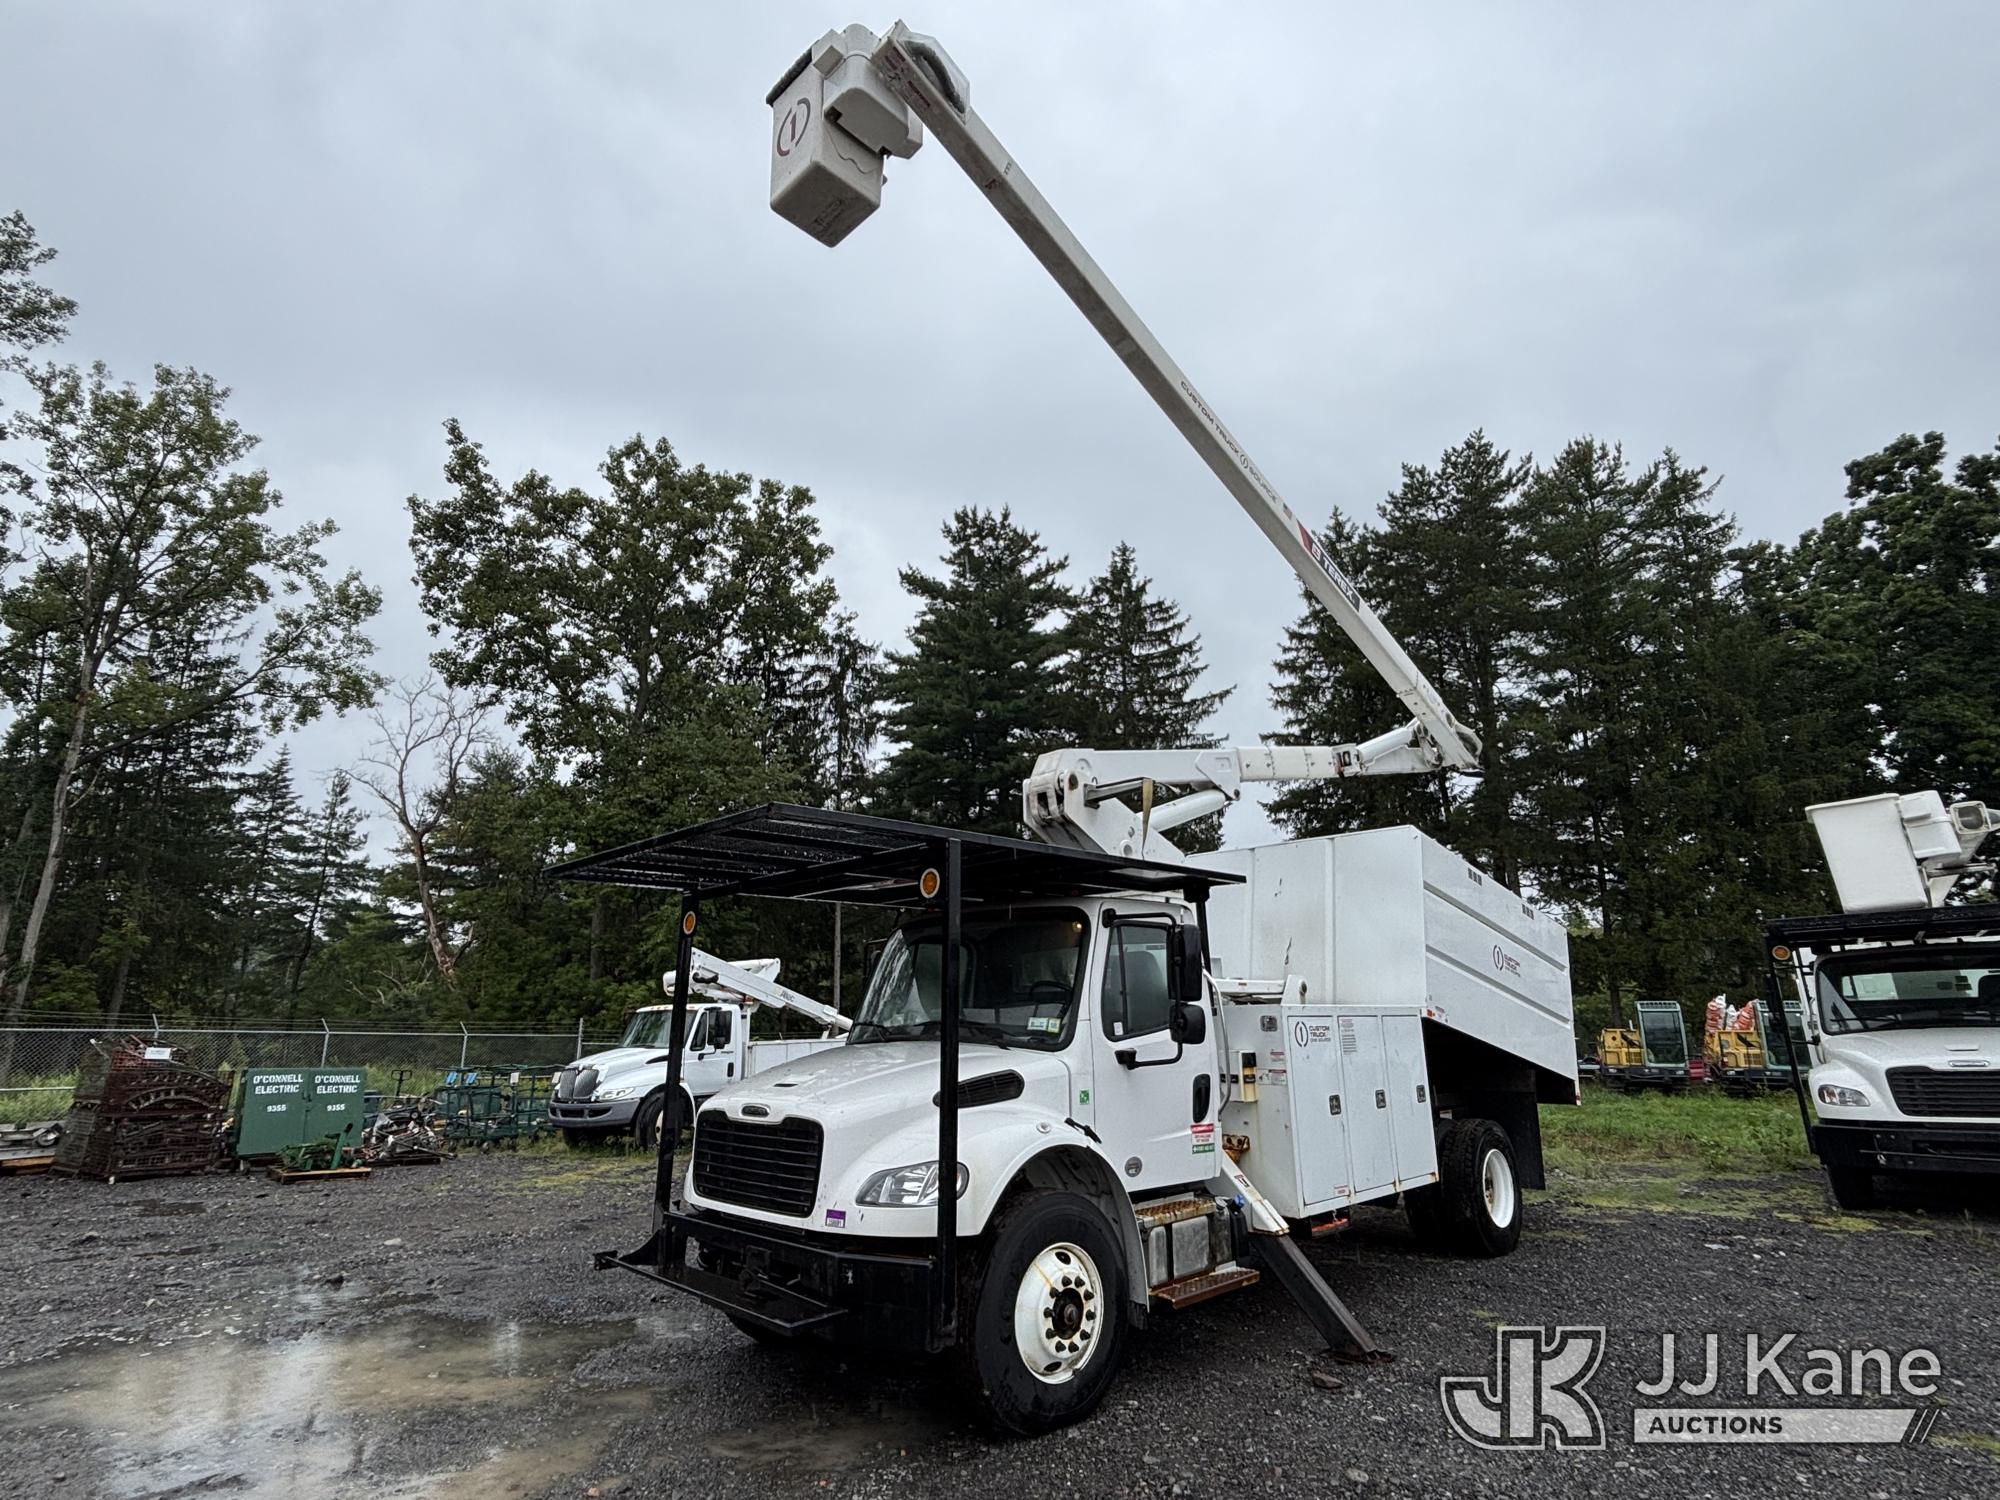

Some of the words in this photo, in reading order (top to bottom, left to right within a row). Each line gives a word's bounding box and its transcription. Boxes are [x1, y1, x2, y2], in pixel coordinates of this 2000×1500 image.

[1181, 381, 1214, 424] CUSTOM
[1215, 423, 1239, 456] TRUCK
[1323, 556, 1356, 605] TEREX
[253, 1074, 303, 1084] O'CONNELL
[315, 1075, 361, 1084] O'CONNELL
[255, 1084, 300, 1094] ELECTRIC
[316, 1085, 358, 1094] ELECTRIC
